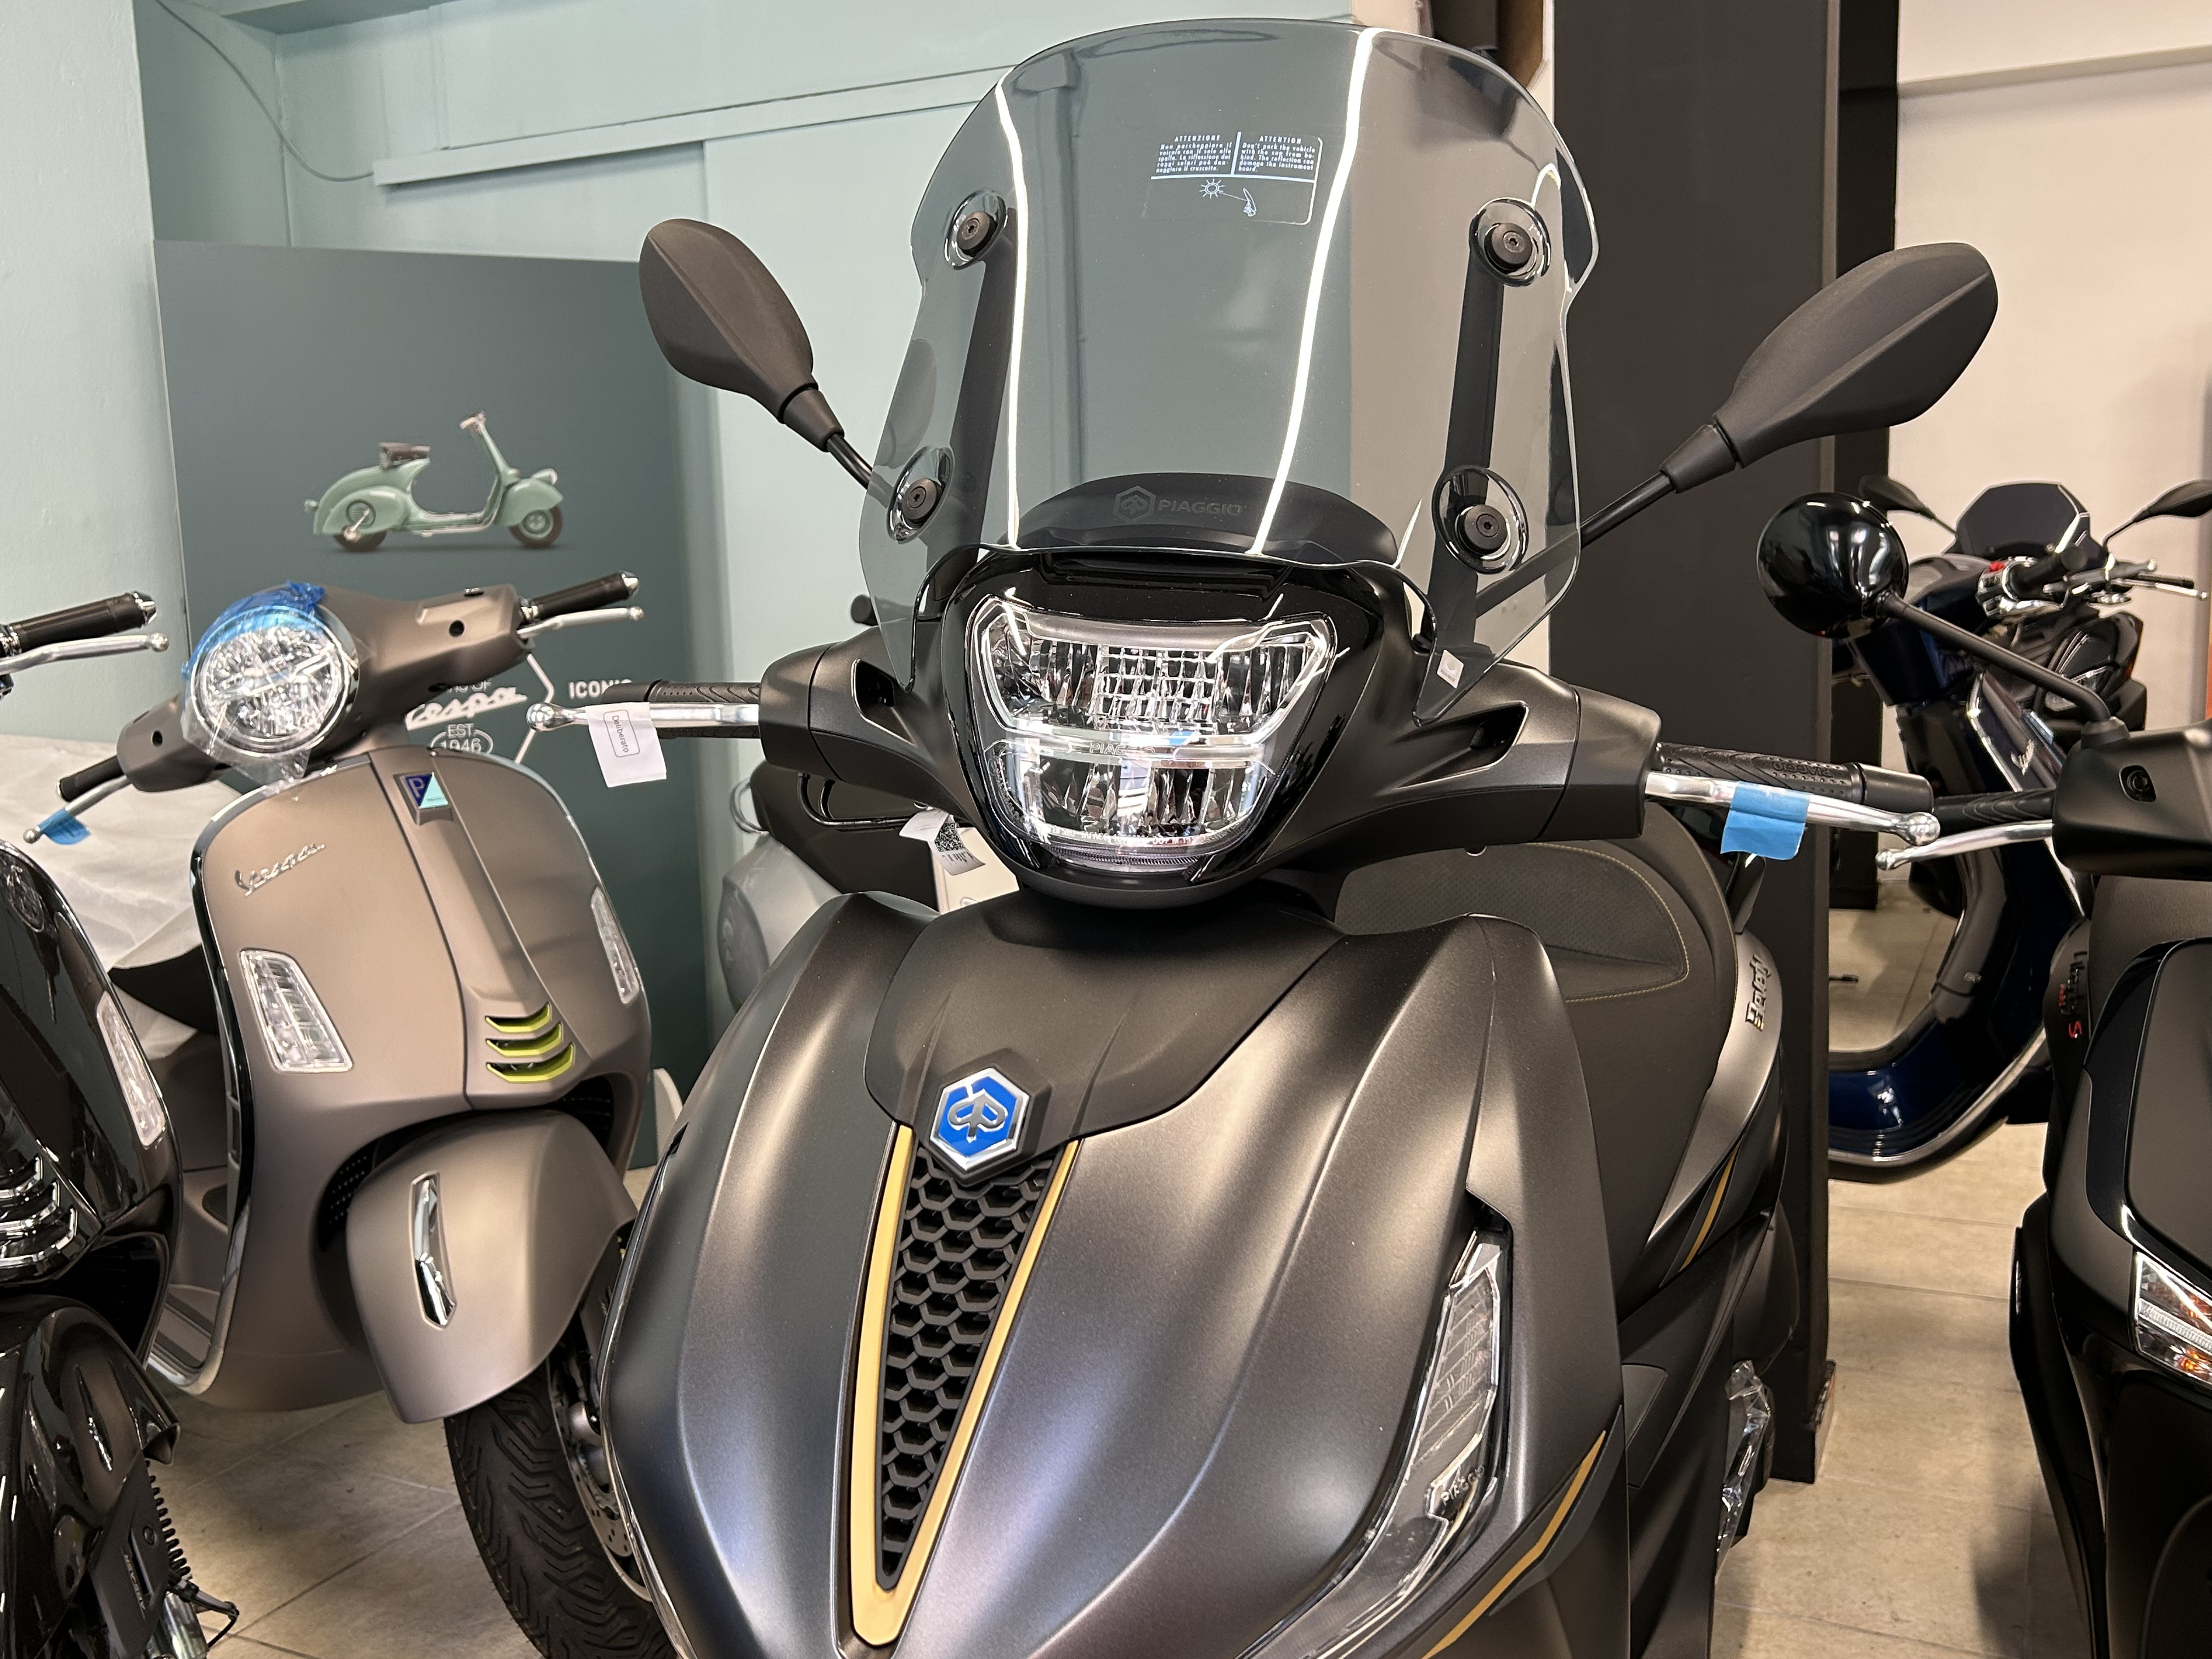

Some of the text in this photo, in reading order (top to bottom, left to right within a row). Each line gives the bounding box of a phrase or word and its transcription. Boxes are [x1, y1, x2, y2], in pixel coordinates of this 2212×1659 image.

[1259, 136, 1301, 144] ATTENTION
[1176, 142, 1223, 150] parcheggiare
[1271, 155, 1301, 163] reflection
[1279, 162, 1313, 171] instrument
[1158, 499, 1243, 516] PIAGGIO
[568, 678, 633, 699] ICON
[612, 715, 629, 753] Deliberato
